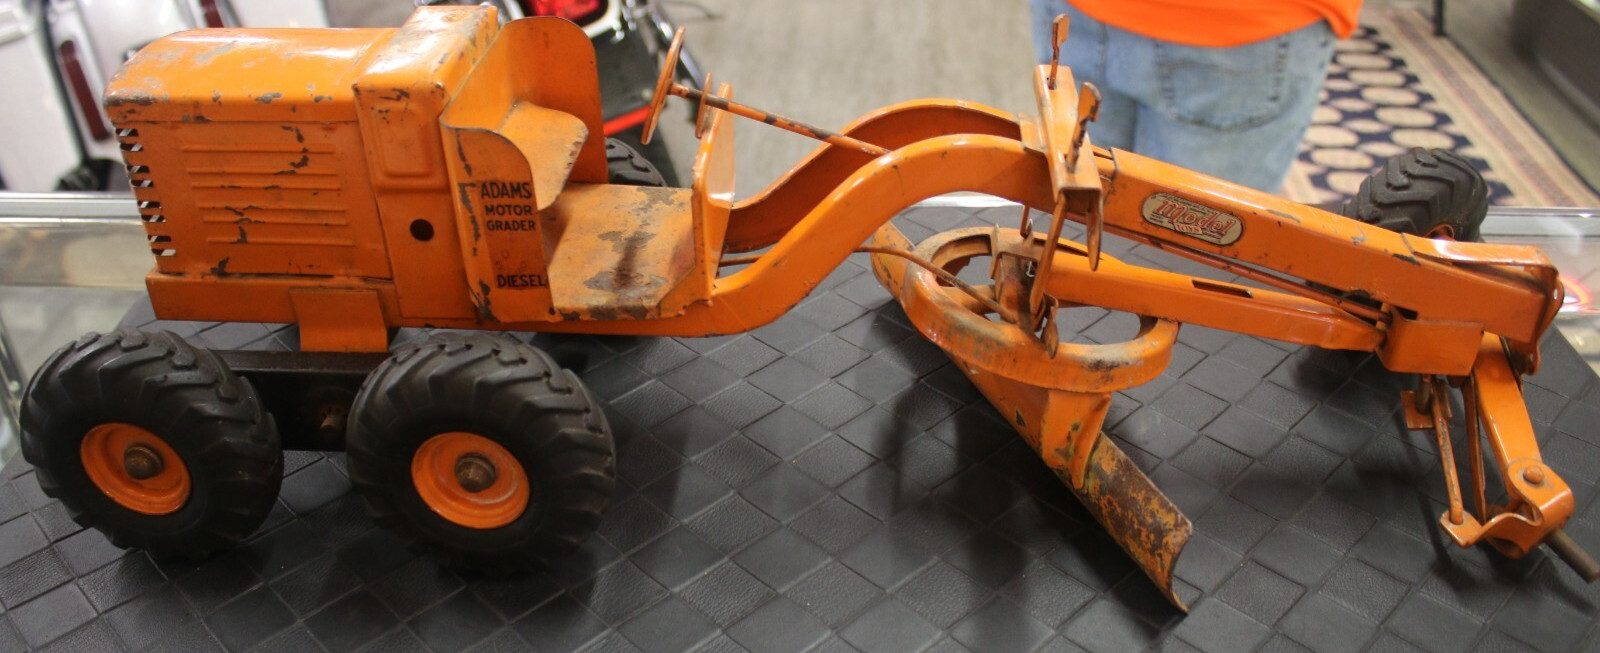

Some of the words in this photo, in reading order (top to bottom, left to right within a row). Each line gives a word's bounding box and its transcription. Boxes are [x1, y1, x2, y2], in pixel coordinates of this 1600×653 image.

[481, 182, 532, 199] ADAMS
[485, 205, 532, 216] MOTOR
[1155, 200, 1235, 235] Model
[486, 220, 536, 231] GRADER
[496, 274, 547, 288] DIESEL
